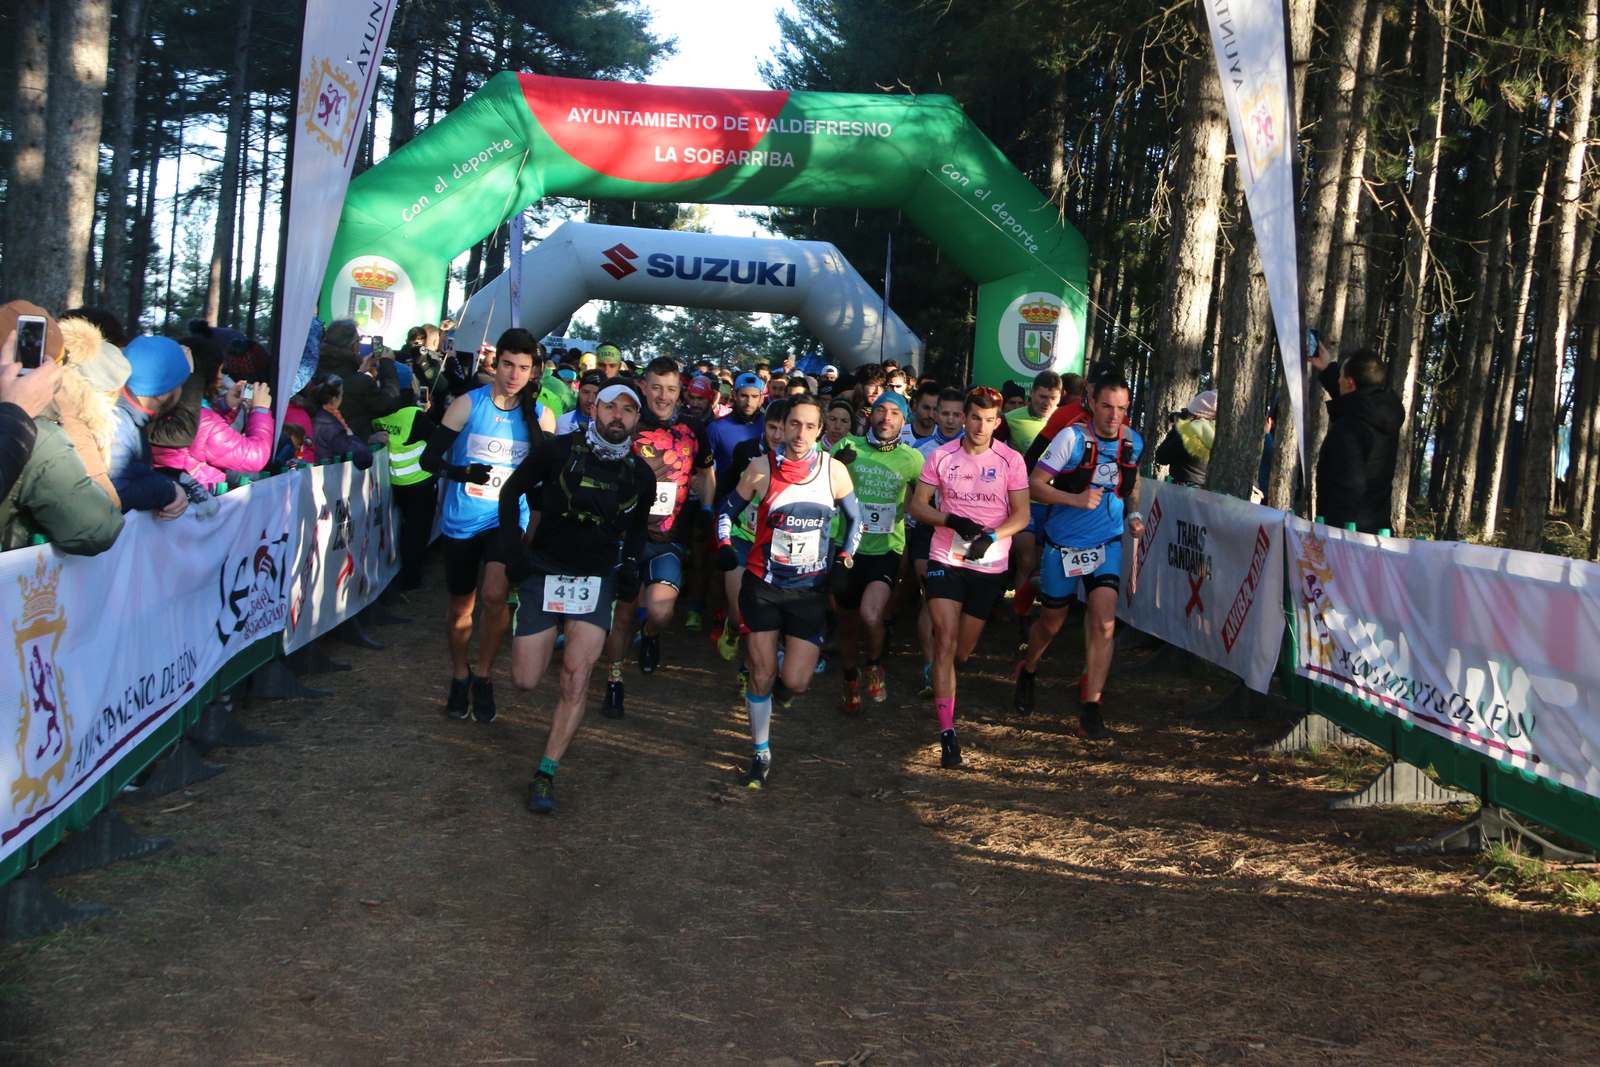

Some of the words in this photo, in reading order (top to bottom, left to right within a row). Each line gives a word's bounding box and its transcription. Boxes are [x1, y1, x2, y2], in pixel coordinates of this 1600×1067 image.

[567, 107, 718, 130] AYUNTAMIENTO
[723, 115, 749, 132] DE
[754, 117, 893, 138] VALDEFRESNO
[654, 146, 678, 163] LA
[683, 147, 795, 168] SOBARRIBA
[401, 195, 431, 223] Con
[434, 176, 450, 194] el
[453, 137, 514, 183] deporte
[941, 163, 970, 187] Con
[974, 187, 992, 201] el
[991, 202, 1040, 254] deporte
[646, 253, 797, 287] SUZUKI
[870, 512, 880, 523] 9
[786, 542, 806, 554] 17
[1071, 551, 1099, 566] 463
[554, 585, 590, 601] 413
